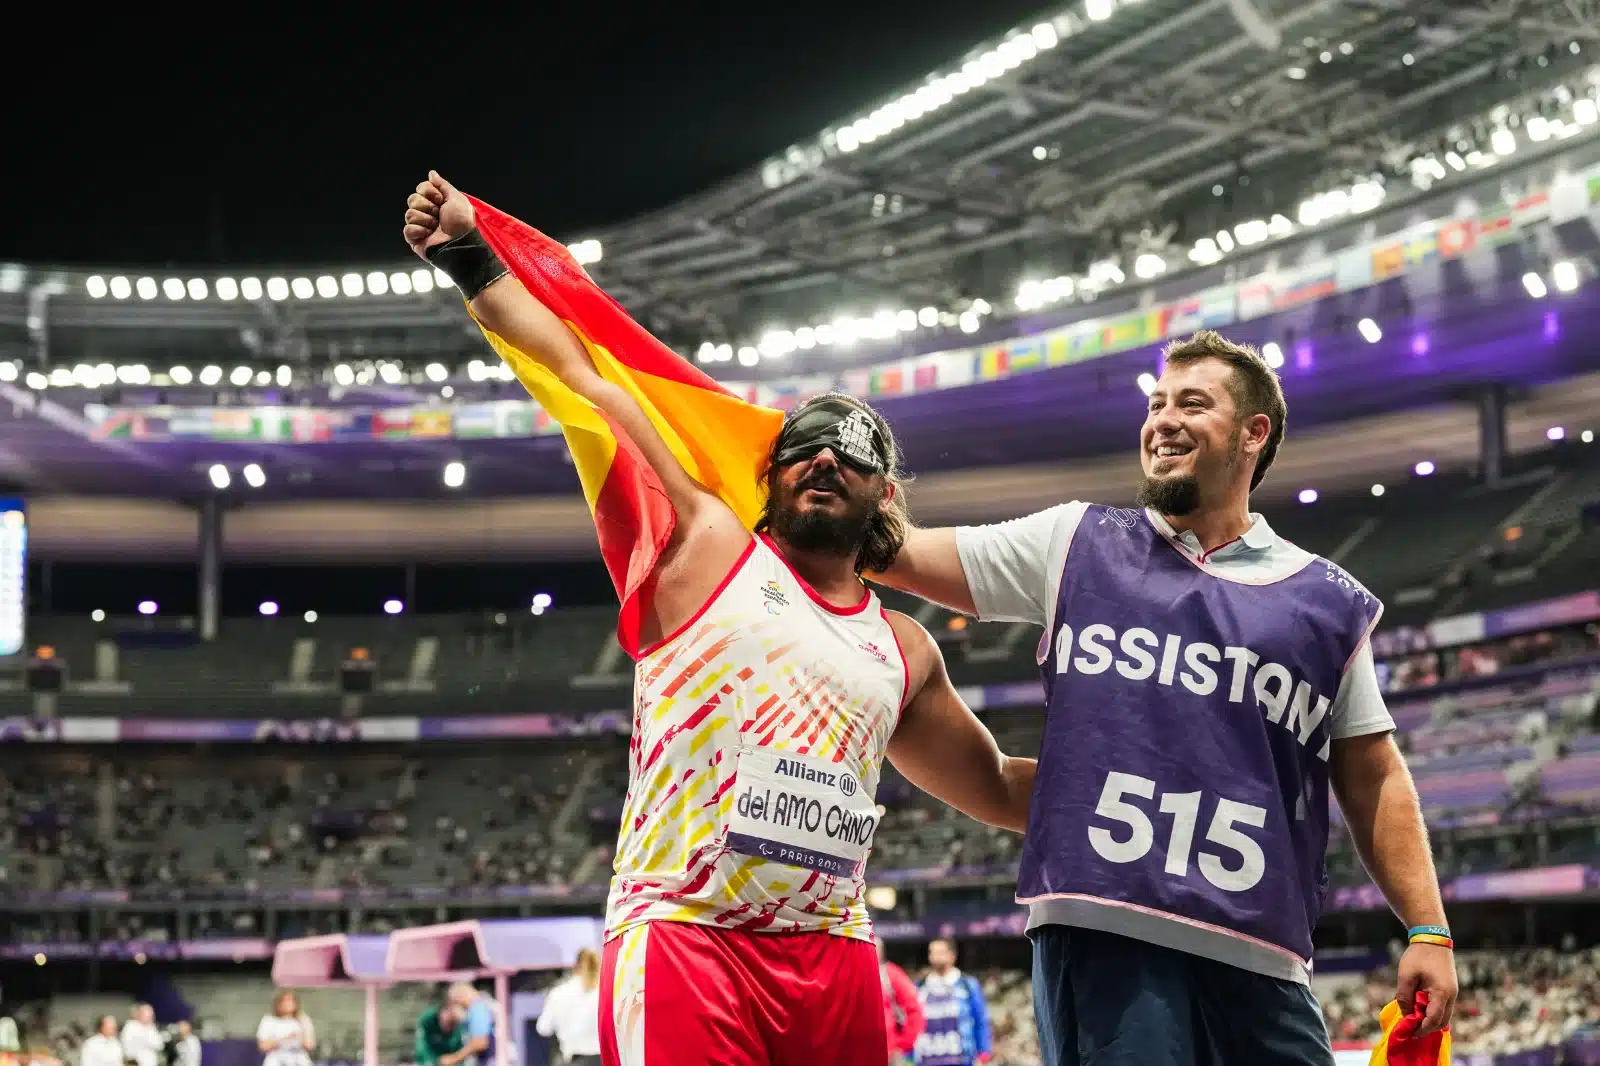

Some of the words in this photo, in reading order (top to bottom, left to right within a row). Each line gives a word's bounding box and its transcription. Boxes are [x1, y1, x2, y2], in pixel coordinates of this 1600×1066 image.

[1056, 622, 1333, 762] ASSISTAN
[738, 786, 771, 821] del
[773, 792, 822, 832] AMO
[825, 805, 875, 845] CANO
[775, 758, 836, 787] Allianz
[1088, 771, 1267, 892] 515
